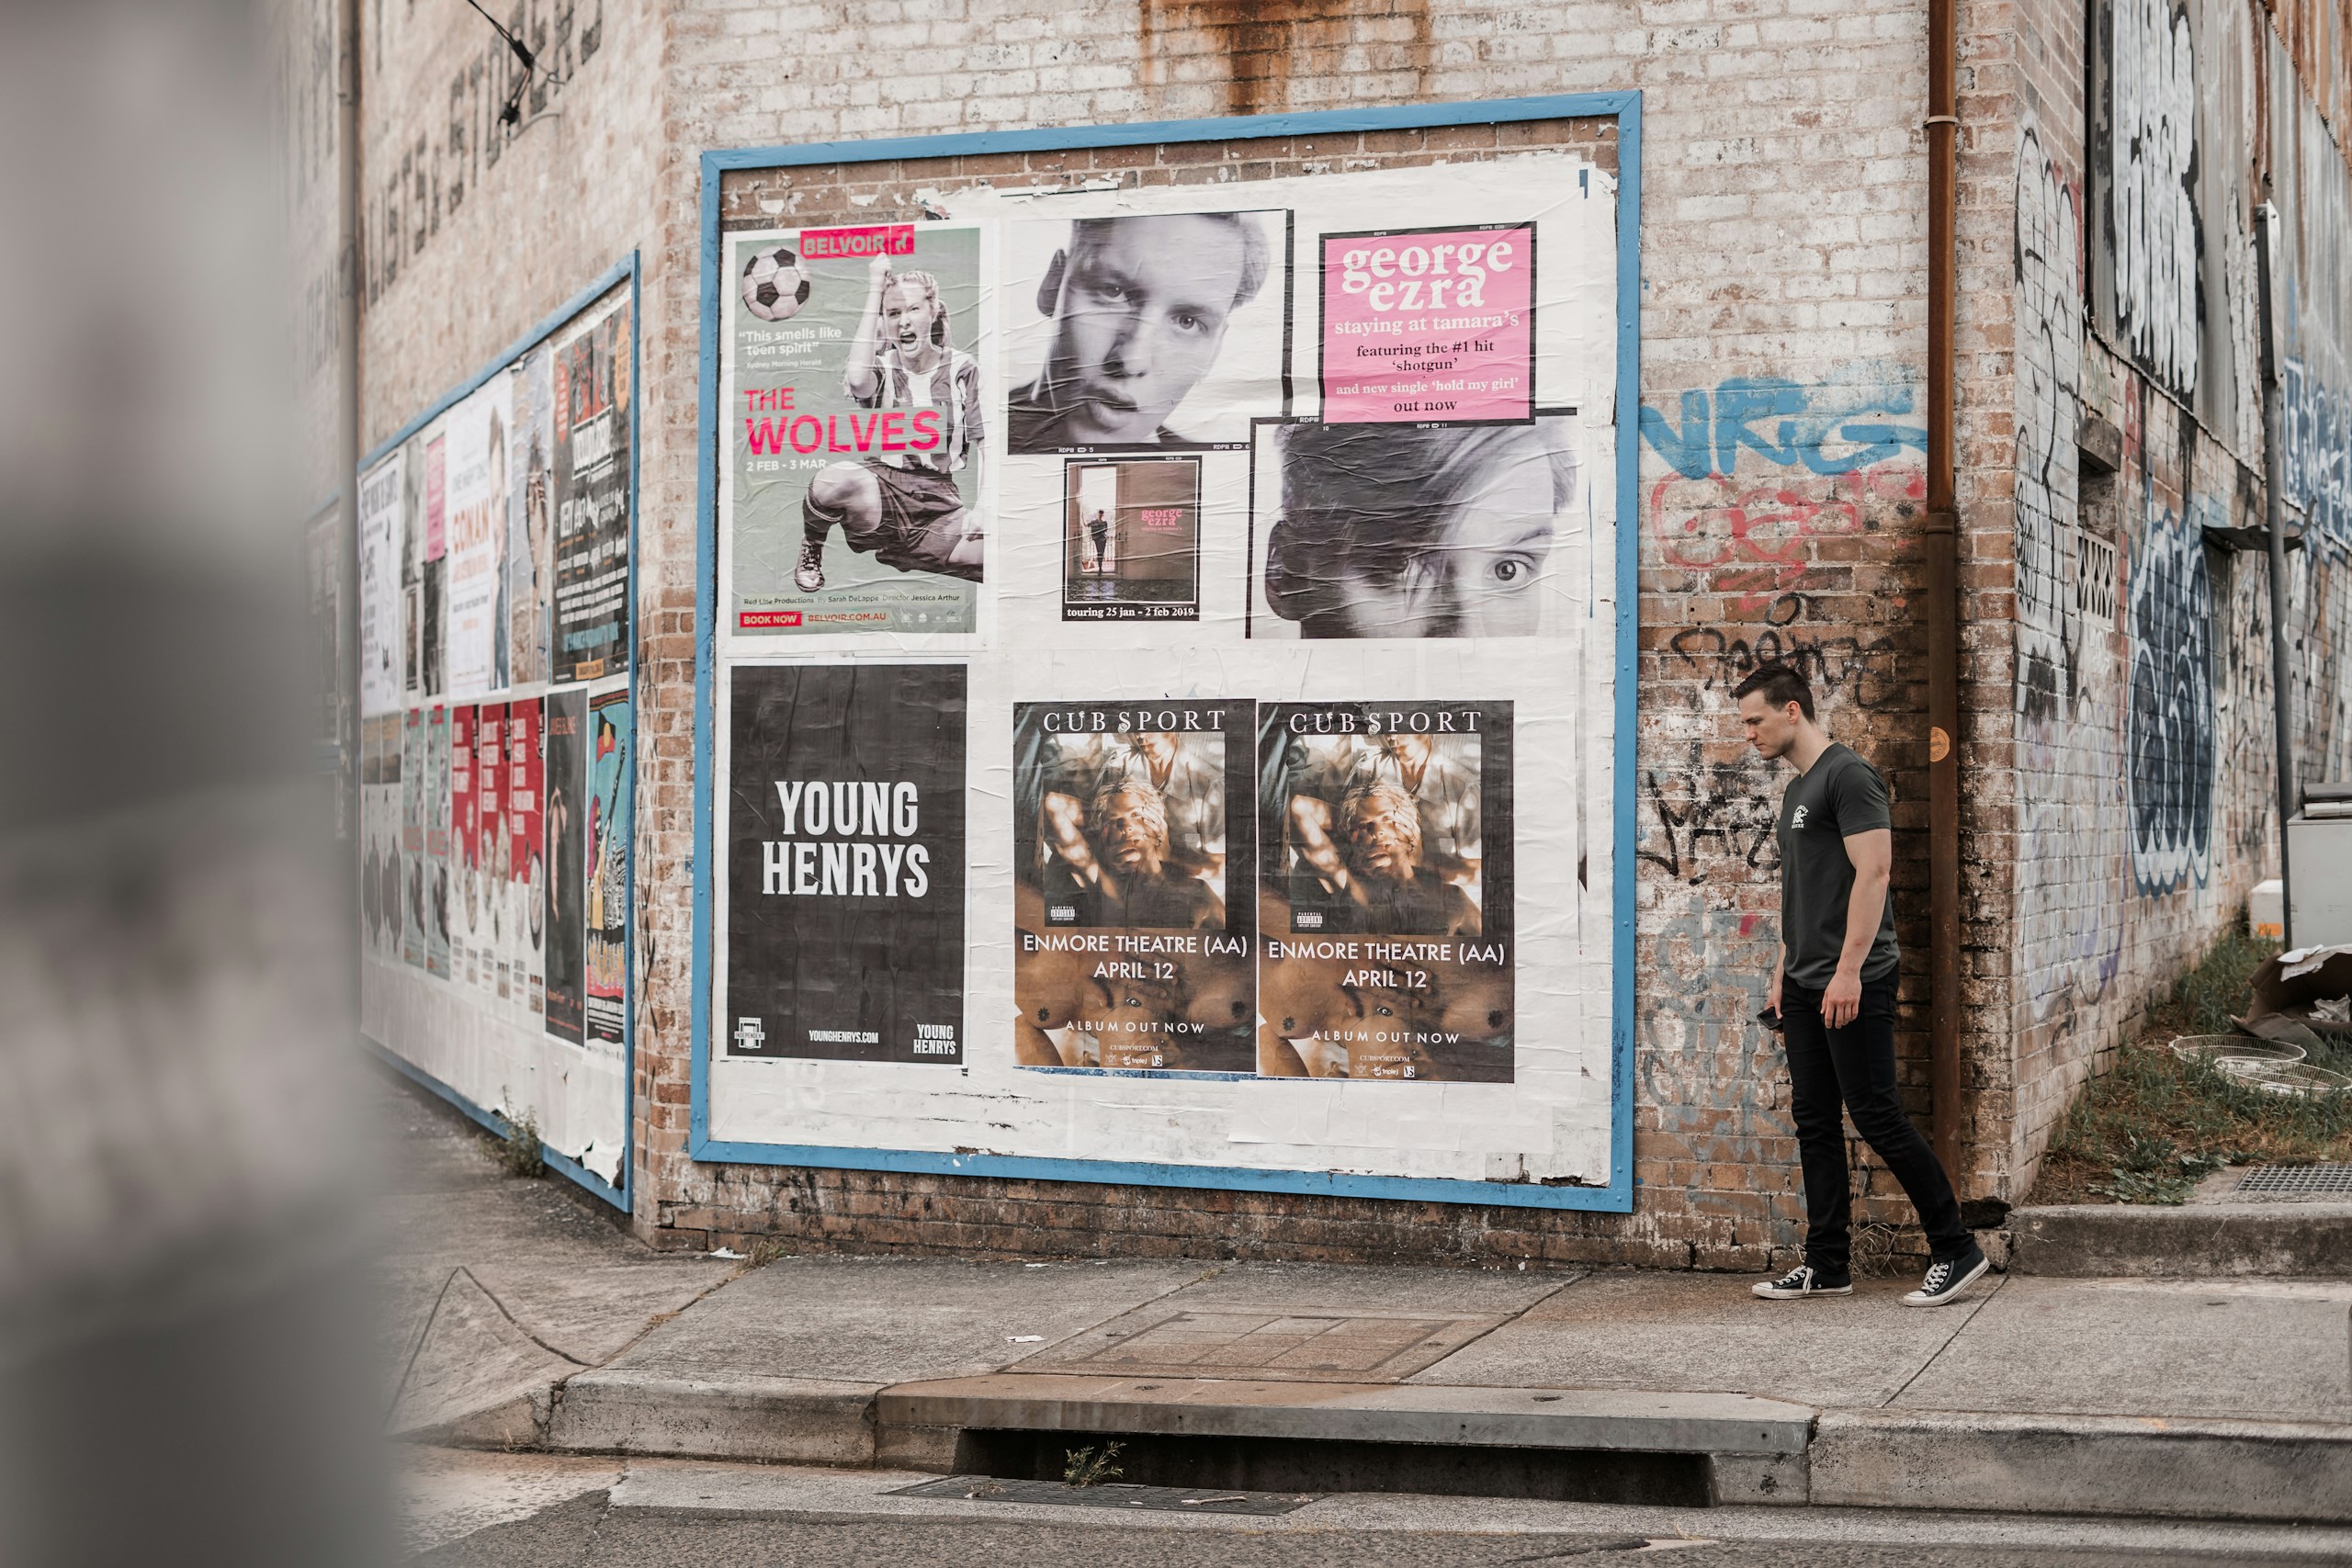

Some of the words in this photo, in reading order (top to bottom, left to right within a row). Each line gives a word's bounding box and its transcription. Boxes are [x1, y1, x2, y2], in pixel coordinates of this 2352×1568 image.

[803, 234, 886, 255] BELVOIR
[1341, 242, 1513, 294] george
[1369, 276, 1485, 312] ezra
[1334, 317, 1403, 336] staying
[1408, 318, 1427, 331] at
[1433, 310, 1520, 330] tamara’s
[739, 330, 772, 343] “This
[775, 327, 816, 341] smells
[820, 327, 842, 338] like
[746, 345, 775, 356] teen
[779, 342, 820, 356] spirit”
[1356, 344, 1422, 357] featuring
[1426, 343, 1448, 355] the
[1452, 341, 1469, 353] #1
[1475, 340, 1495, 352] hit
[1392, 358, 1459, 373] ‘shotgun’
[1336, 384, 1360, 395] and
[1363, 384, 1387, 394] new
[1391, 381, 1428, 395] single
[1431, 379, 1464, 391] ‘hold
[1468, 382, 1488, 393] my
[1491, 378, 1520, 391] girl’
[744, 388, 796, 412] THE
[1394, 400, 1419, 412] out
[1424, 400, 1458, 412] now
[746, 411, 941, 456] WOLVES
[746, 461, 753, 472] 2
[757, 461, 779, 471] FEB
[789, 459, 797, 470] 3
[799, 459, 827, 469] MAR
[1141, 509, 1182, 522] george
[1148, 517, 1176, 525] ezra
[743, 615, 772, 625] BOOK
[774, 615, 797, 624] NOW
[808, 612, 887, 622] BELVOIR.COM.AU
[1068, 607, 1104, 619] touring
[1106, 607, 1117, 616] 25
[1119, 607, 1136, 618] jan
[1145, 607, 1152, 616] 2
[1154, 606, 1170, 616] feb
[1172, 606, 1194, 616] 2019
[1044, 711, 1106, 733] CUB
[1118, 710, 1226, 734] SPORT
[1290, 711, 1356, 733] CUB
[1367, 711, 1481, 735] SPORT
[774, 781, 919, 837] YOUNG
[763, 841, 931, 898] HENRYS
[1023, 935, 1110, 953] ENMORE
[1115, 935, 1196, 953] THEATRE
[1204, 935, 1248, 958] (AA)
[1268, 941, 1358, 959] ENMORE
[1364, 942, 1452, 961] THEATRE
[1459, 942, 1505, 966] (AA)
[1093, 961, 1146, 979] APRIL
[1153, 963, 1174, 979] 12
[1341, 969, 1397, 988] APRIL
[1406, 970, 1427, 988] 12
[917, 1023, 954, 1040] YOUNG
[1065, 1020, 1119, 1032] ALBUM
[1125, 1021, 1159, 1033] OUT
[1165, 1023, 1205, 1034] NOW
[808, 1029, 879, 1043] YOUNGHENRYS.COM
[1311, 1030, 1369, 1042] ALBUM
[1375, 1032, 1409, 1043] OUT
[1417, 1032, 1460, 1045] NOW
[913, 1039, 956, 1055] HENRYS
